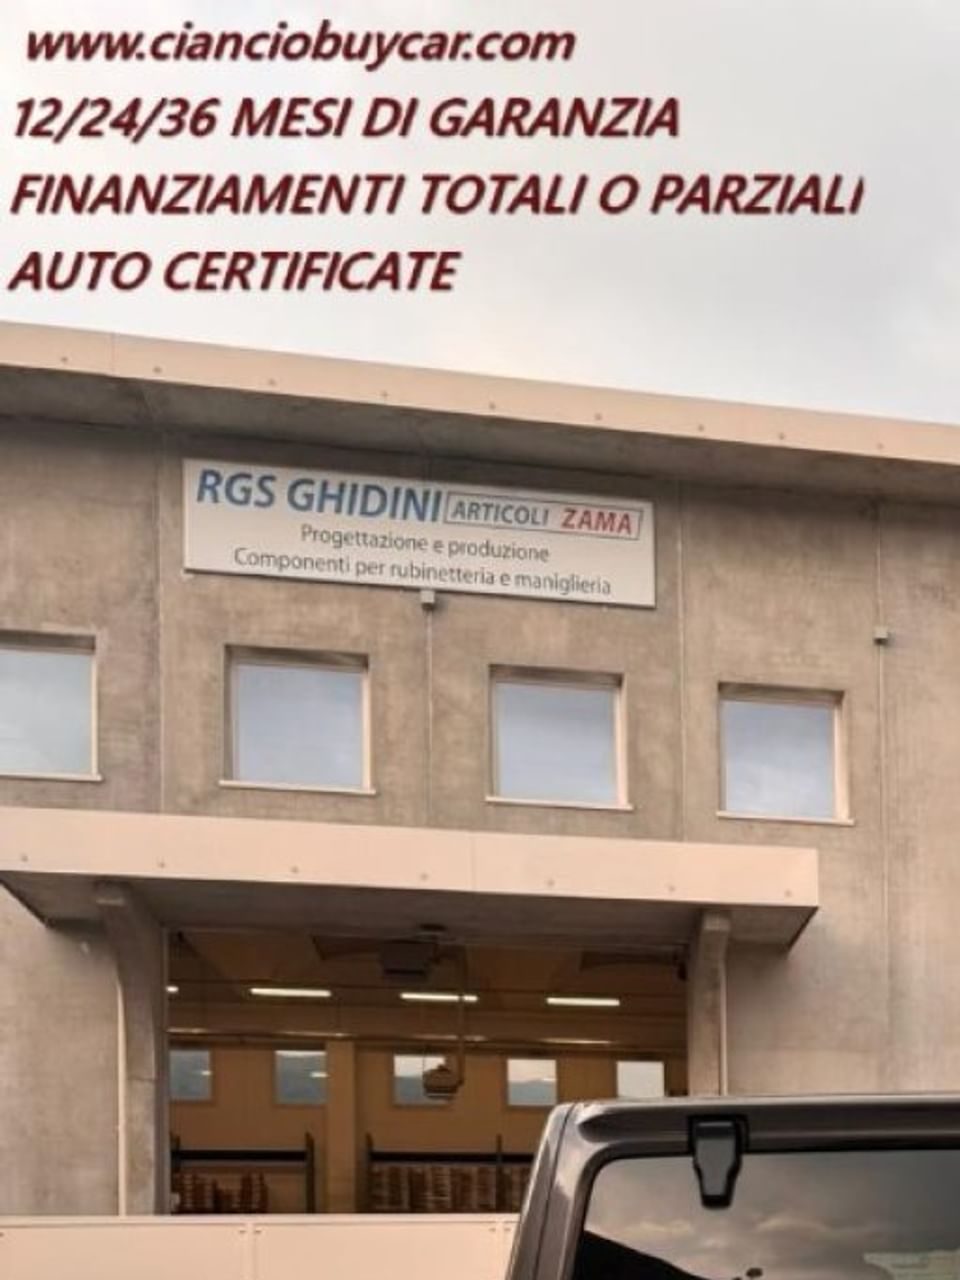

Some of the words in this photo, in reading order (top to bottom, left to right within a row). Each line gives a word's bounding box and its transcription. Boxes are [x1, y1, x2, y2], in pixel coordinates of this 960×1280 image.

[197, 469, 276, 508] RGS
[286, 478, 443, 523] GHIDINI
[451, 502, 549, 527] ARTICOLI
[561, 507, 633, 535] ZAMA
[300, 524, 428, 551] Progettazione
[432, 540, 443, 551] e
[447, 539, 550, 564] produzione
[233, 547, 350, 575] Componenti
[355, 559, 386, 580] per
[390, 563, 494, 587] rubinetteria
[499, 573, 511, 585] e
[515, 573, 612, 597] maniglieria
